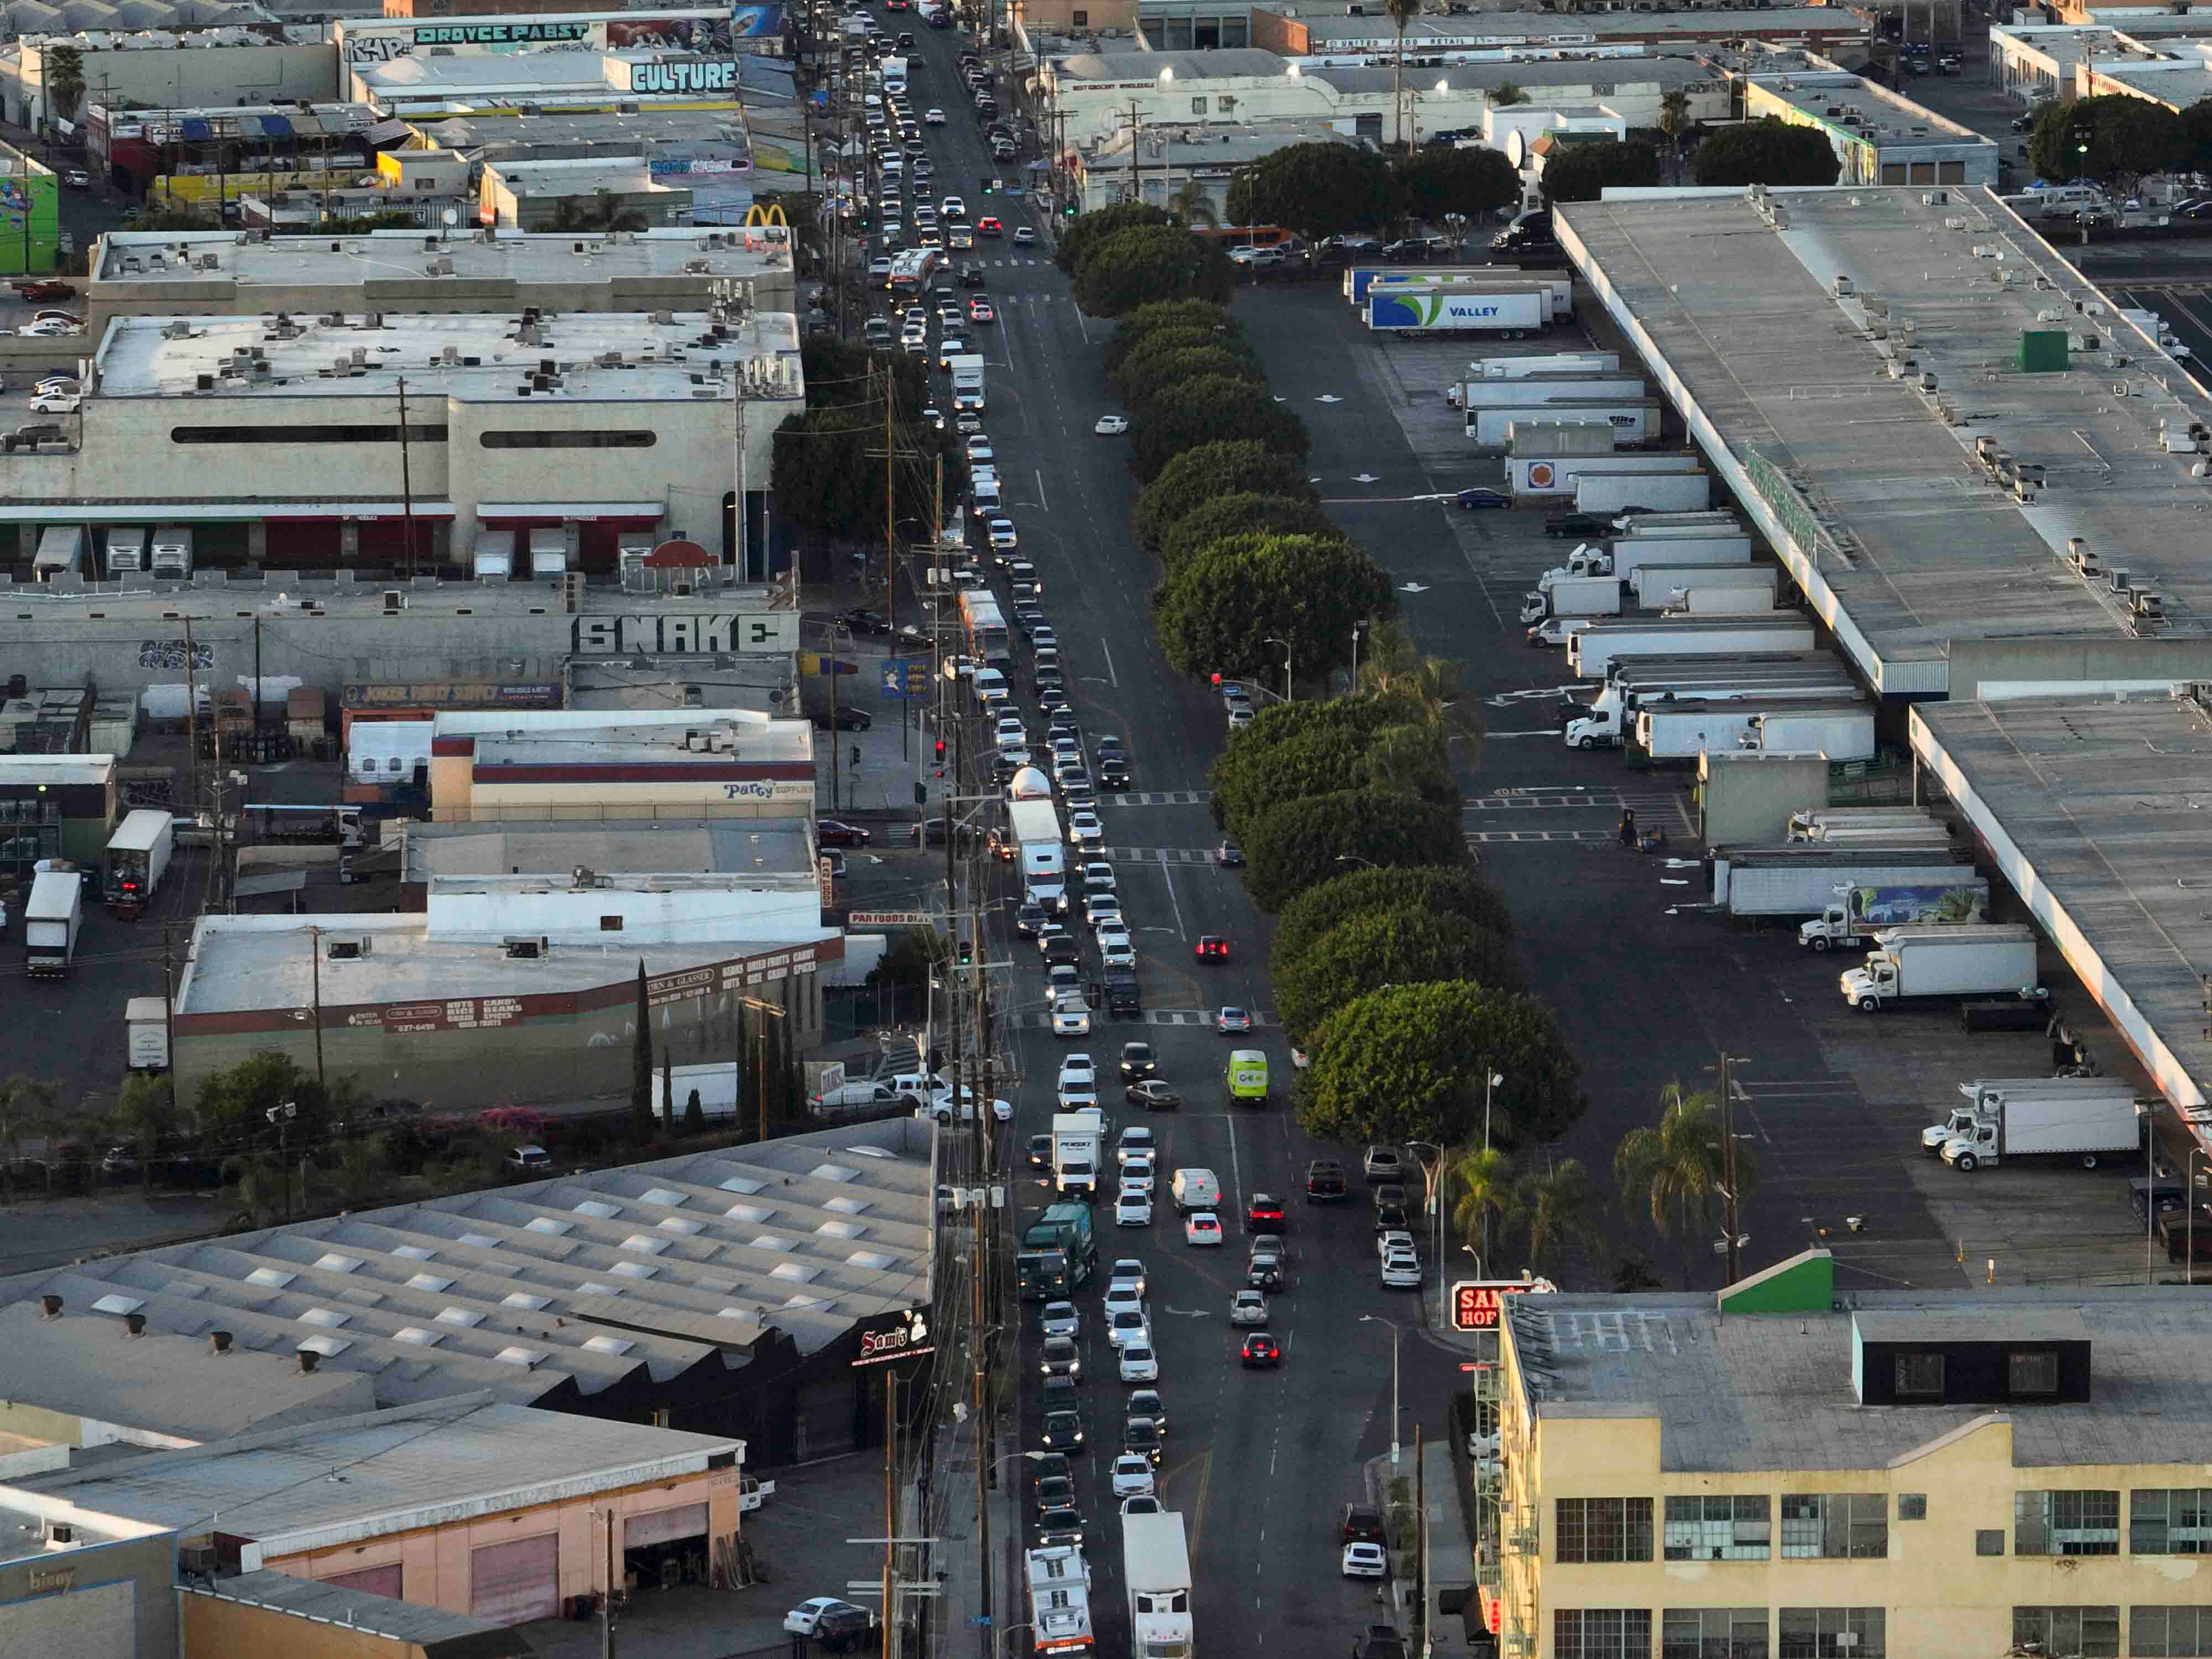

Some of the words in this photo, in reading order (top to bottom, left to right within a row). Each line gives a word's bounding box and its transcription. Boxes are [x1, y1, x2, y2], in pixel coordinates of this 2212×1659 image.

[632, 62, 737, 91] CULTURE
[1449, 307, 1499, 317] VALLEY
[573, 615, 779, 654] SNAKE
[724, 783, 773, 799] Party
[853, 914, 872, 923] PAN
[874, 914, 904, 922] FOODS
[646, 982, 666, 993] ORN
[667, 979, 674, 988] &
[676, 971, 710, 985] GLASSER
[446, 1000, 474, 1008] NUTS
[483, 1004, 523, 1013] BEANS
[860, 1327, 907, 1358] Sam's
